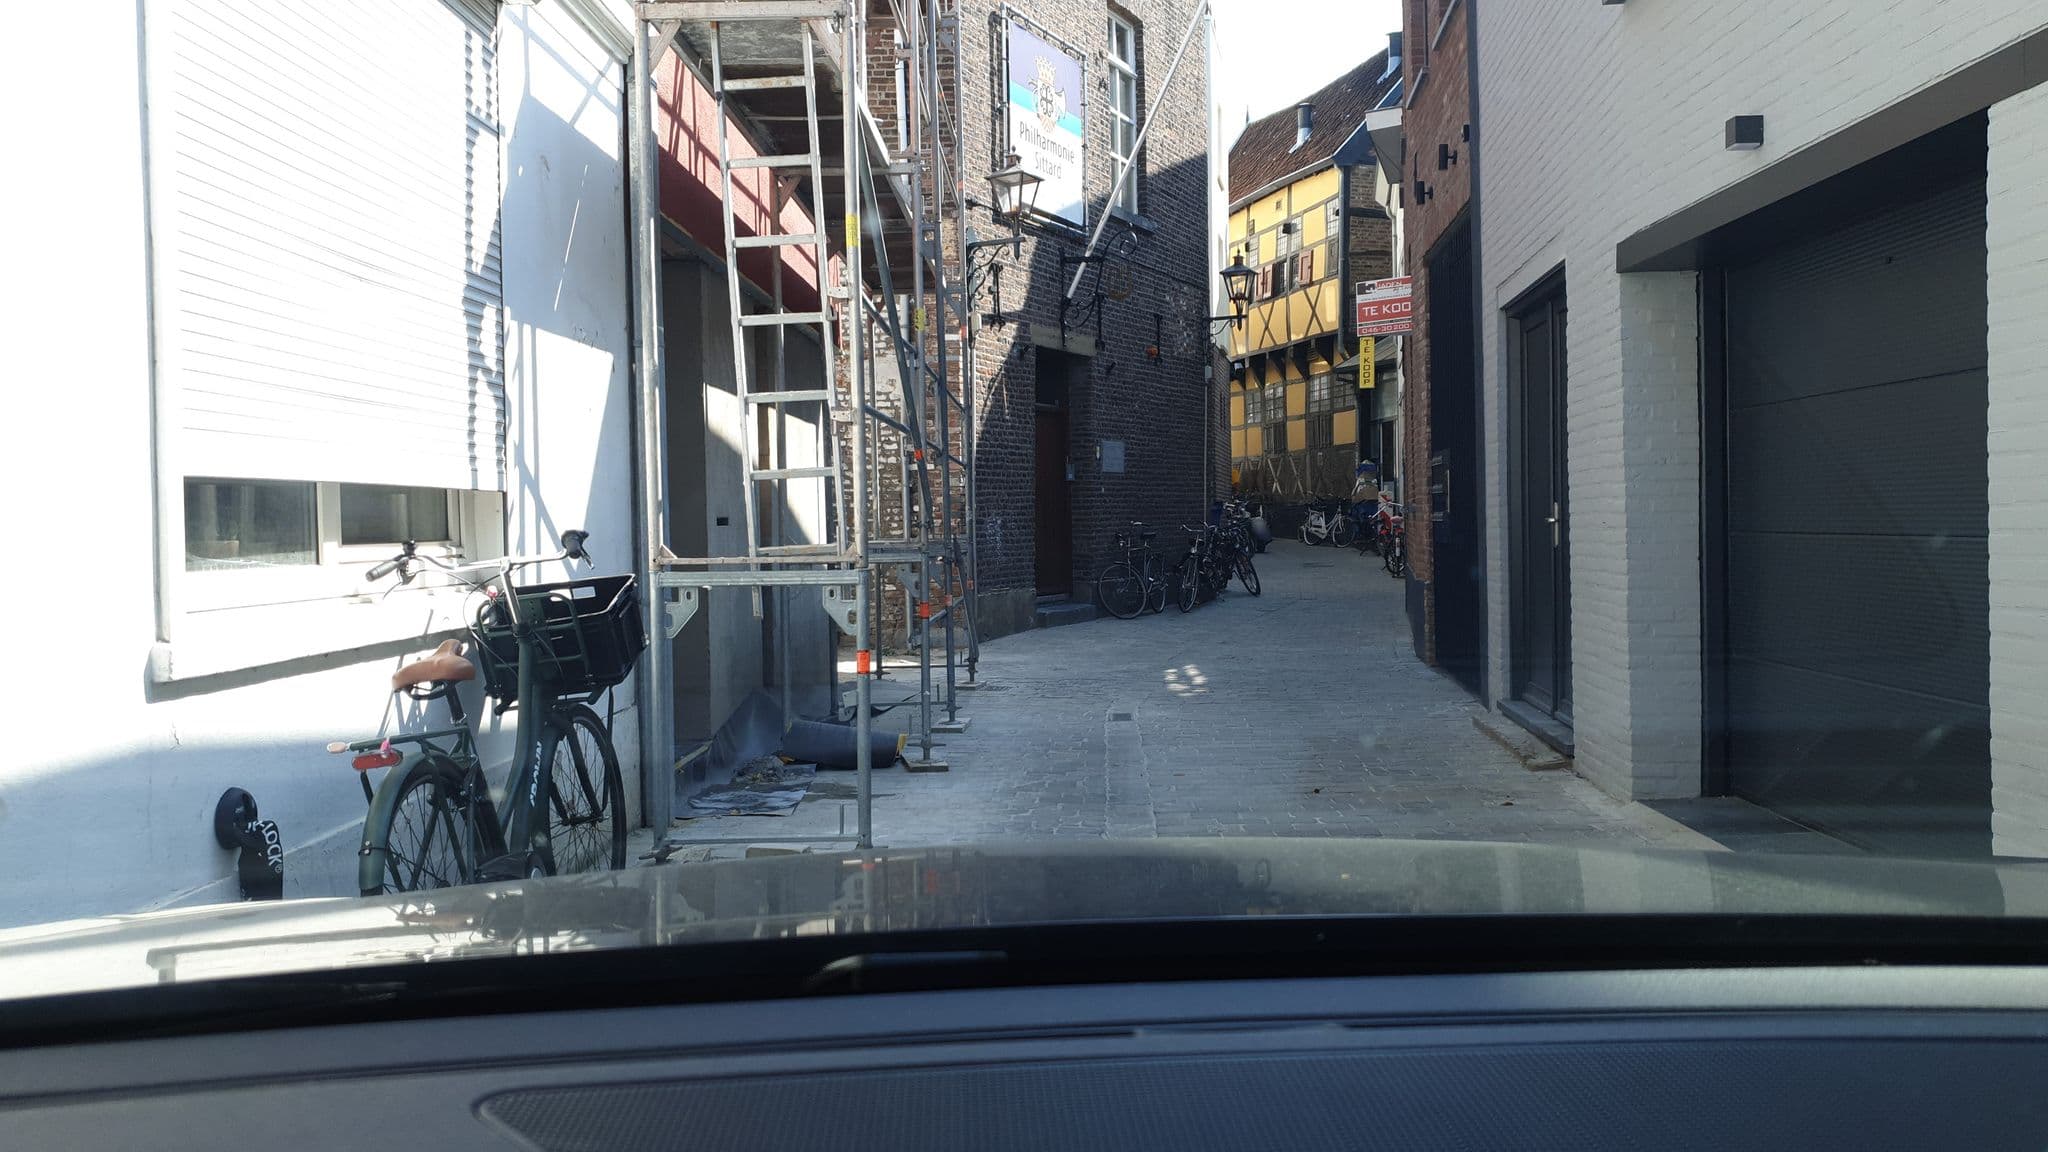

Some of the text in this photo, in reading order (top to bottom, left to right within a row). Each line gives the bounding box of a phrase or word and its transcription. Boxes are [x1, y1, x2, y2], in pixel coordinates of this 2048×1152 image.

[1020, 121, 1075, 164] Philharmonie
[1035, 151, 1062, 179] Sittard
[1362, 301, 1411, 316] TE KOO
[1363, 339, 1371, 385] TE KOOP
